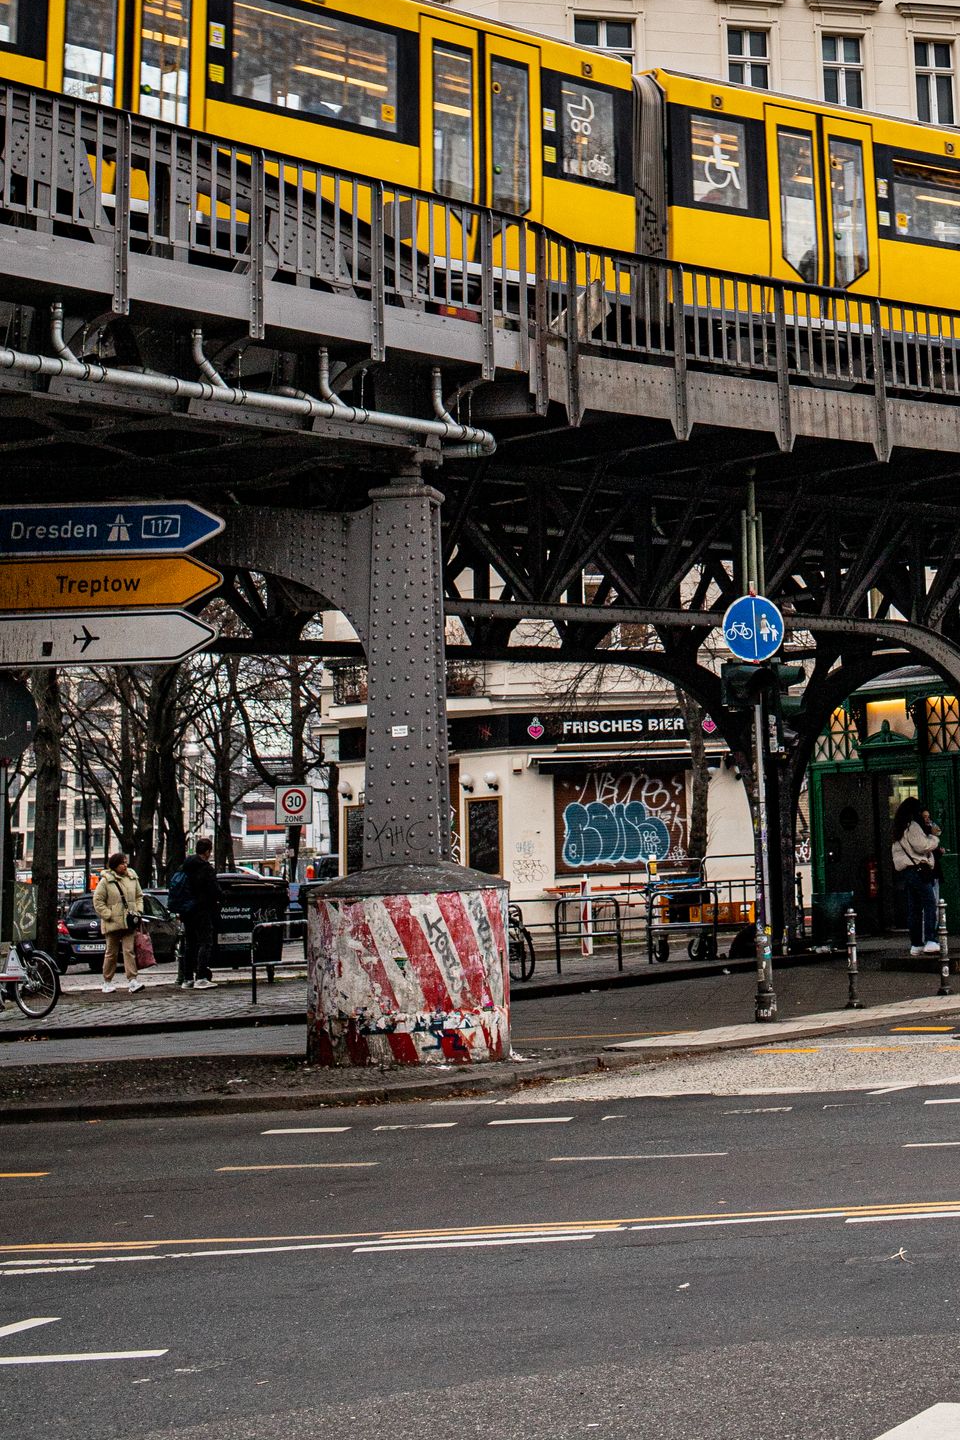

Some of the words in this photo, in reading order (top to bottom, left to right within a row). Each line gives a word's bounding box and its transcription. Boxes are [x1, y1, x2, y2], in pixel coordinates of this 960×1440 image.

[11, 520, 98, 540] Dresden
[150, 519, 173, 535] 117
[56, 575, 141, 598] Treptow
[563, 719, 643, 734] FRISCHES
[287, 795, 302, 808] 30
[284, 815, 304, 823] ZONE
